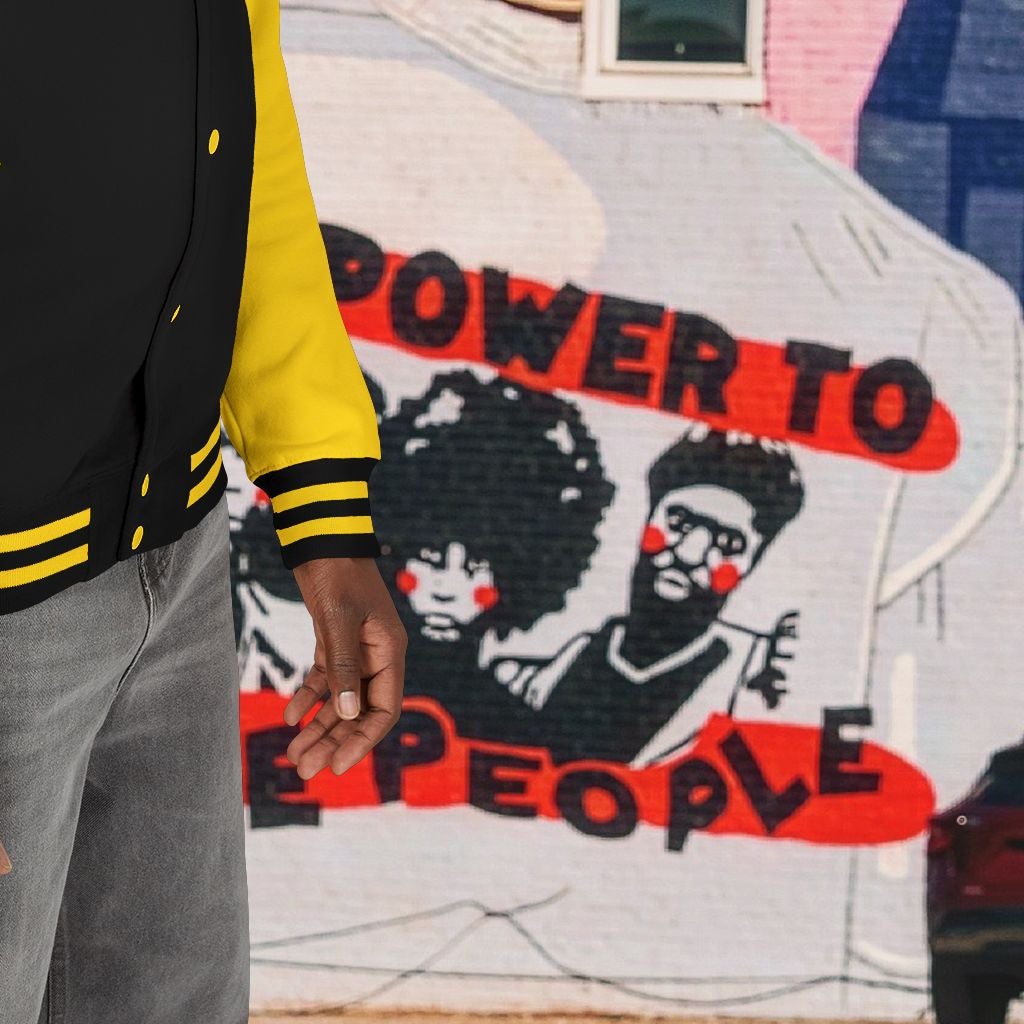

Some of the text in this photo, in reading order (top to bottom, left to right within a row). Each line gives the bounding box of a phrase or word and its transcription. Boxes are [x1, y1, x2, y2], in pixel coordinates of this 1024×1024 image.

[318, 223, 934, 454] POWER TO
[375, 704, 883, 853] PEOPLE
